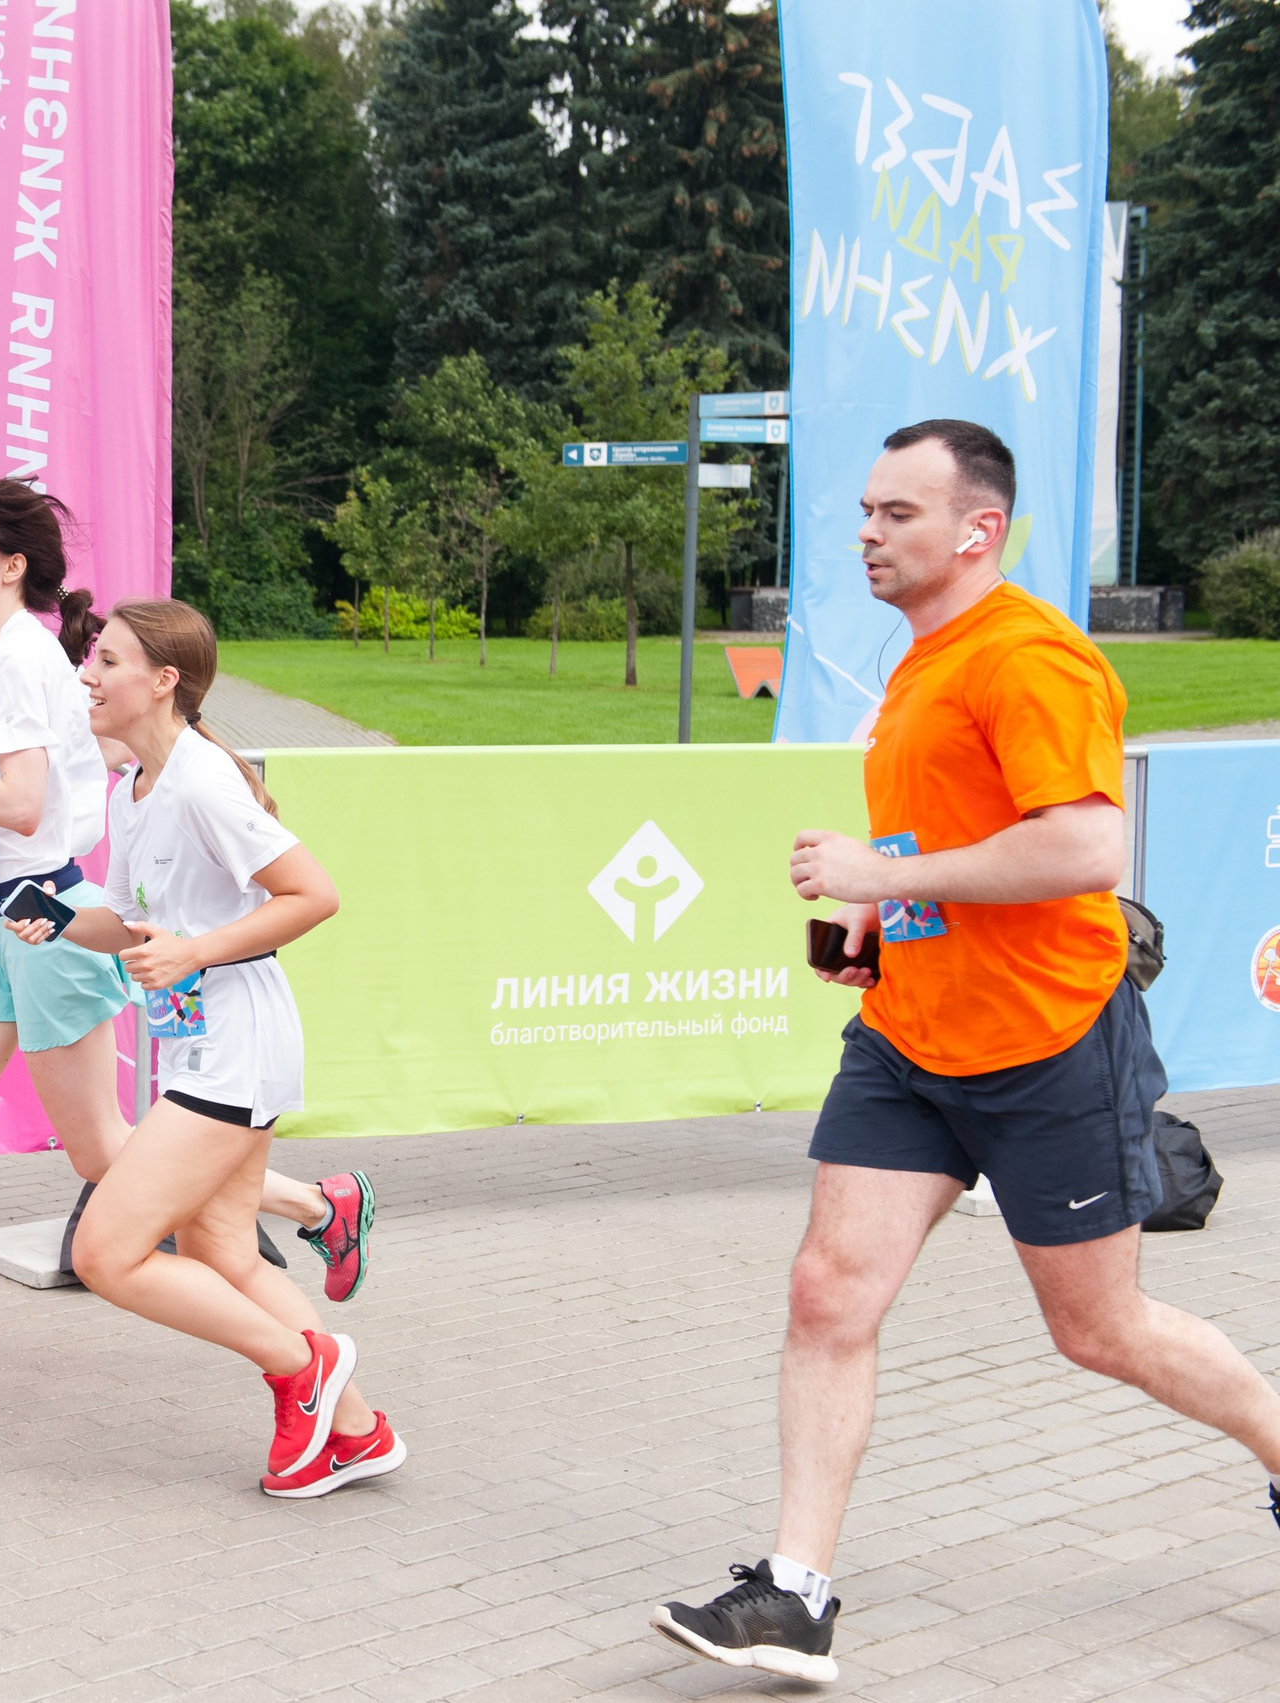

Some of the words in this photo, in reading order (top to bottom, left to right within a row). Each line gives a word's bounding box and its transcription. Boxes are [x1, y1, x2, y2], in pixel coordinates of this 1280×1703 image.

[491, 972, 630, 1010] ЛИНИЯ
[644, 966, 789, 1003] ЖИЗНИ
[489, 1013, 723, 1046] благотворительный
[730, 1011, 789, 1044] фонд
